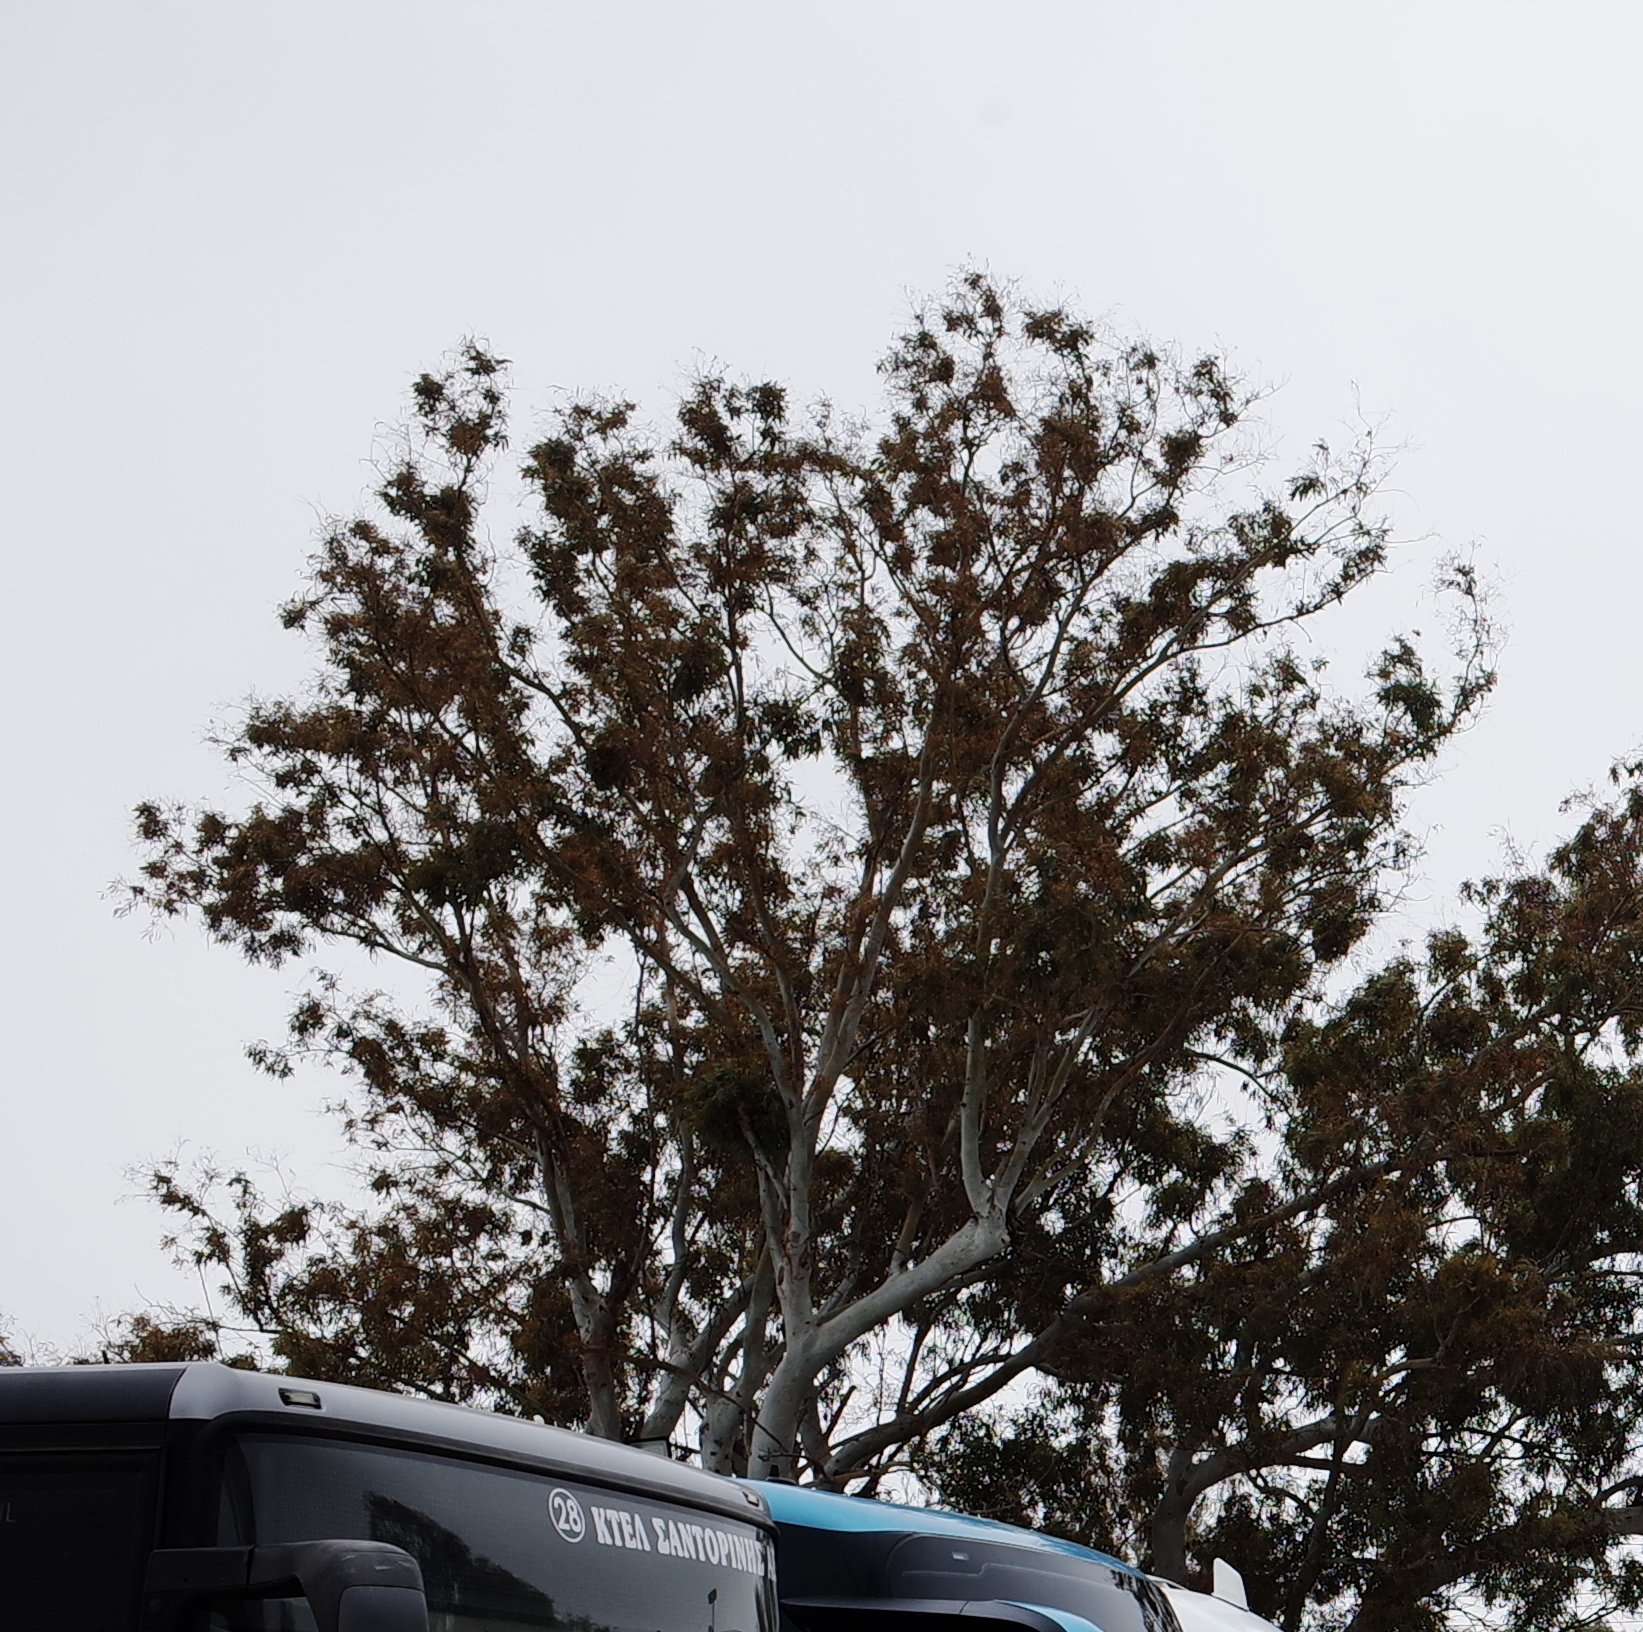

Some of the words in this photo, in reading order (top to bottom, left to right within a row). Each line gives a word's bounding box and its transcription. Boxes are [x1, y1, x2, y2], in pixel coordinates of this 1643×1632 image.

[554, 1496, 582, 1533] 28
[591, 1506, 651, 1552] ΚΤΕΛ
[652, 1517, 765, 1577] ΣΑΝΤΟΡΙΝΗΣ
